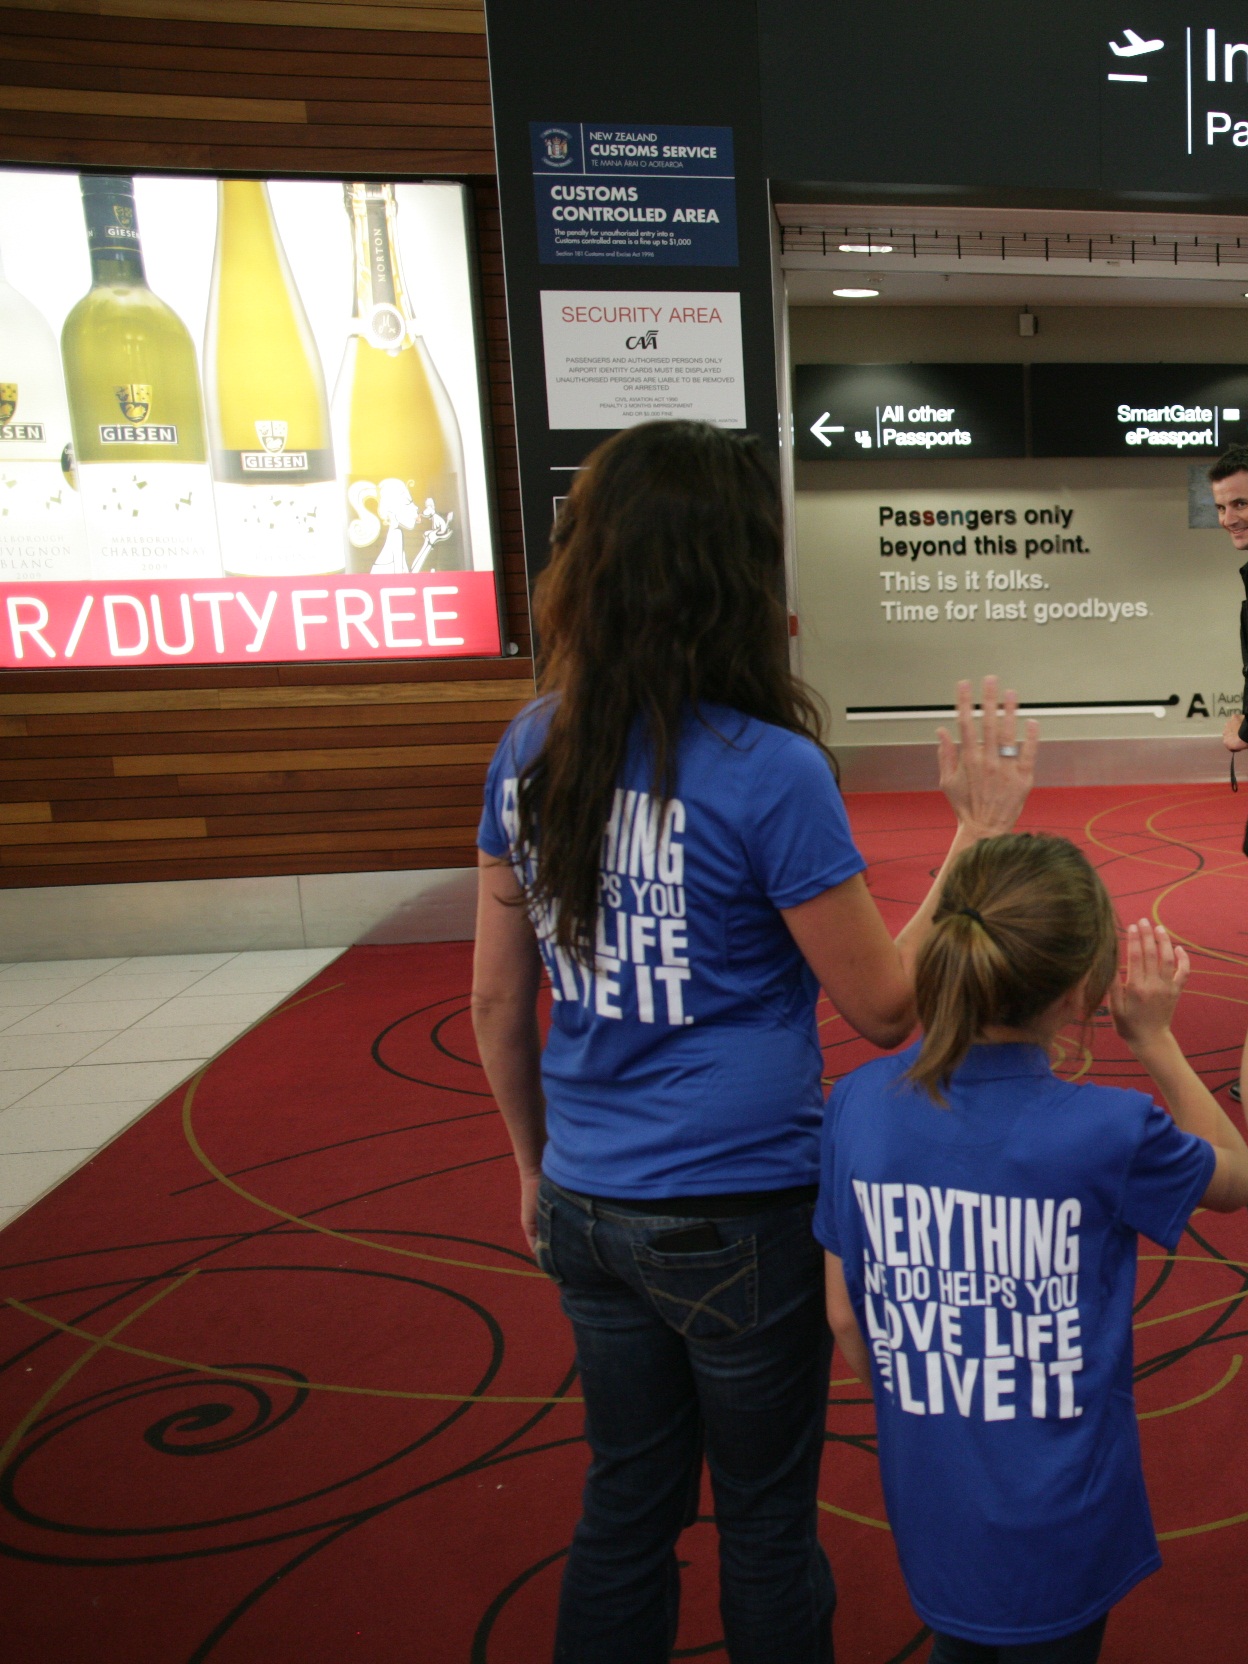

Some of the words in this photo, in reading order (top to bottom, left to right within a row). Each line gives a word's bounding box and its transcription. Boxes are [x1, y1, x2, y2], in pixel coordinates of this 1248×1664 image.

[589, 131, 613, 141] NEW
[615, 132, 657, 142] ZEALAND
[590, 144, 659, 158] CUSTOMS
[662, 146, 717, 159] SERVICE
[591, 159, 600, 167] TE
[600, 160, 623, 168] MANA
[648, 161, 684, 169] AOTEAROA
[550, 185, 639, 202] CUSTOMS
[551, 206, 667, 223] CONTROLLED
[672, 208, 720, 224] AREA
[554, 228, 566, 236] The
[566, 229, 589, 238] penalty
[600, 229, 639, 237] unauthorised
[639, 231, 656, 239] entry
[554, 236, 581, 244] Customs
[581, 237, 611, 245] controlled
[652, 239, 661, 247] up
[669, 238, 692, 247] $1,000
[373, 228, 386, 282] MORTON
[561, 305, 662, 323] SECURITY
[669, 307, 722, 324] AREA
[623, 384, 634, 392] OR
[634, 384, 670, 392] ARRESTED
[882, 405, 904, 424] All
[907, 405, 955, 424] other
[1117, 404, 1213, 424] SmartGate
[102, 424, 173, 441] GIESEN
[882, 427, 972, 450] Passports
[1125, 427, 1214, 450] ePassport
[246, 455, 305, 469] GIESEN
[879, 505, 1017, 531] Passengers
[1024, 504, 1074, 530] only
[101, 546, 206, 557] CHARDONNAY
[879, 535, 967, 561] beyond
[975, 534, 1017, 555] this
[1025, 534, 1091, 559] point.
[879, 570, 931, 593] This
[937, 570, 958, 592] is
[965, 570, 980, 592] it
[986, 569, 1050, 592] folks.
[291, 586, 464, 651] FREE
[880, 600, 939, 623] Time
[945, 599, 978, 622] for
[984, 598, 1027, 622] last
[1034, 597, 1154, 625] goodbyes.
[629, 878, 687, 918] YOU
[595, 905, 690, 968] LIFE
[634, 964, 694, 1026] IT.
[894, 1265, 931, 1303] DO
[937, 1268, 1018, 1309] HELPS
[1024, 1273, 1079, 1315] YOU
[863, 1293, 963, 1357] LOVE
[984, 1306, 1083, 1362] LIFE
[895, 1350, 1016, 1422] LIVE
[1030, 1356, 1084, 1420] IT.
